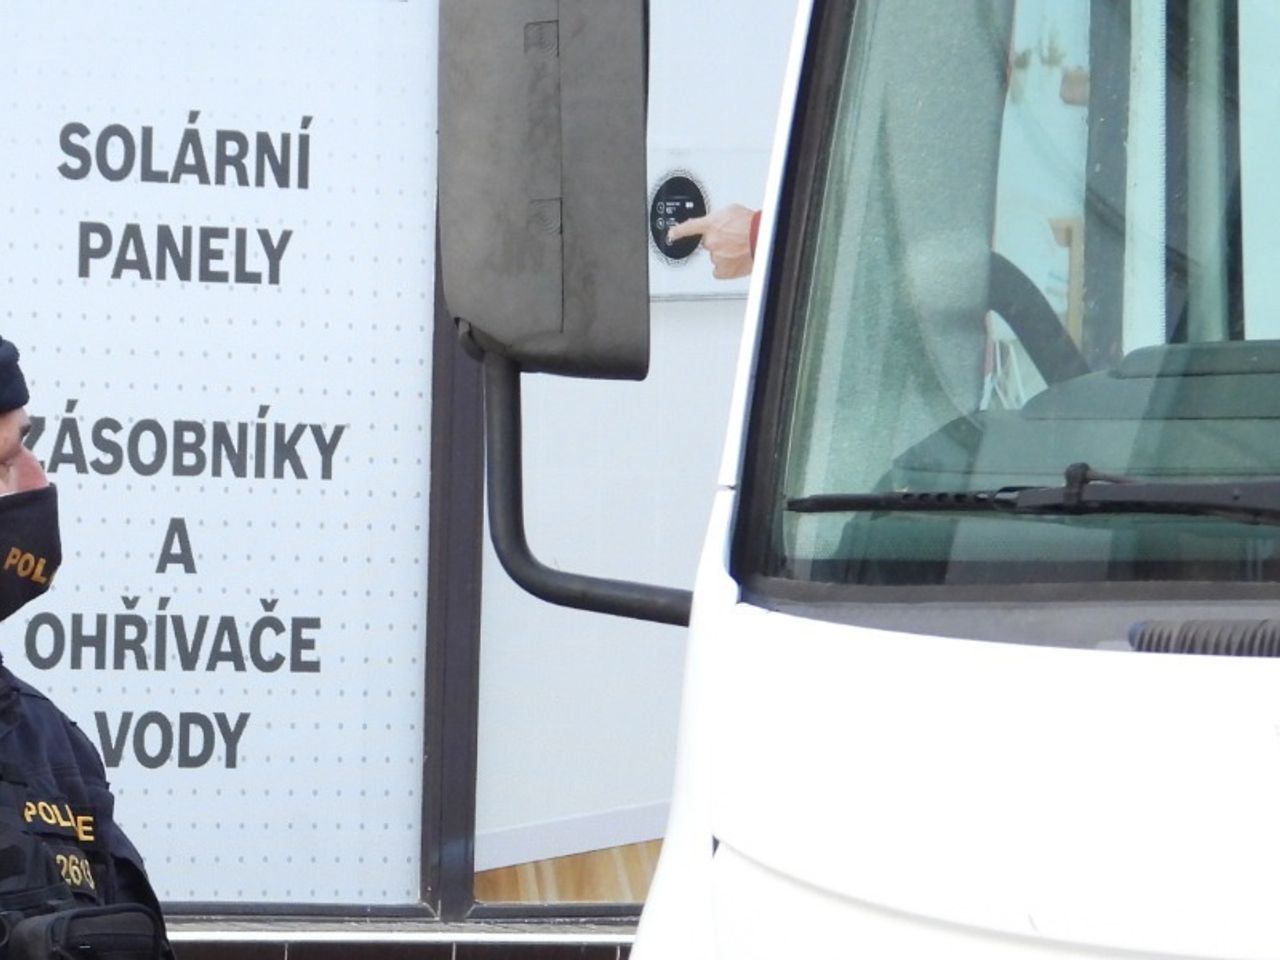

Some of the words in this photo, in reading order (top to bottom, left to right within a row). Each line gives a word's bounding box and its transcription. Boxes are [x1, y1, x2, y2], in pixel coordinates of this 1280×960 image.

[57, 110, 313, 189] SOLÁRNÍ
[78, 221, 293, 285] PANELY
[155, 517, 197, 574] A
[24, 595, 321, 673] OHŘÍVAČE
[94, 710, 251, 769] VODY
